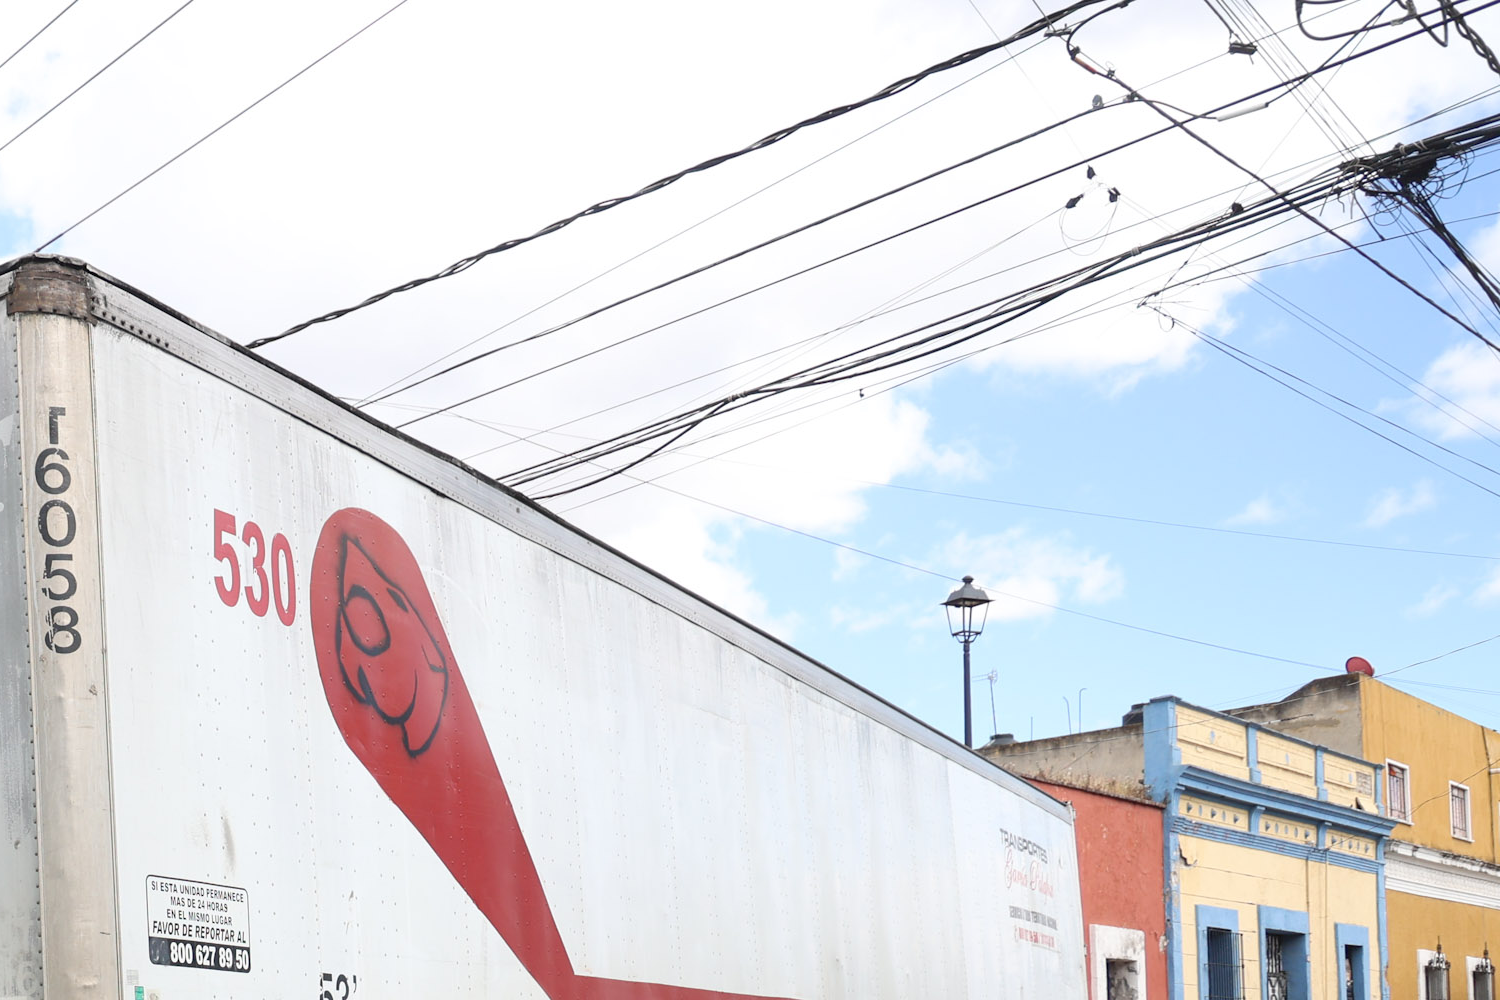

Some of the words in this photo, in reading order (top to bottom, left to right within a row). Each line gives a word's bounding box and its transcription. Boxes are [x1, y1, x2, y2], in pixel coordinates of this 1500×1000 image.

[35, 406, 83, 655] 16058
[213, 508, 296, 627] 530
[999, 828, 1048, 864] TRANSPORTES
[151, 881, 158, 890] SI
[160, 882, 178, 893] ESTA
[180, 885, 204, 897] UNIDAD
[206, 888, 244, 903] PERMANECE
[170, 896, 185, 907] MAS
[187, 899, 196, 908] DE
[198, 900, 205, 909] 24
[207, 901, 228, 912] HORAS
[167, 909, 176, 919] EN
[178, 910, 186, 920] EL
[188, 912, 210, 923] MISMO
[212, 916, 232, 926] LUGAR
[153, 921, 179, 936] FAVOR
[183, 924, 193, 937] DE
[196, 926, 234, 942] REPORTAR
[237, 930, 246, 943] AL
[170, 942, 192, 964] 800
[196, 945, 216, 966] 627
[219, 947, 232, 968] 89
[236, 950, 249, 970] 50
